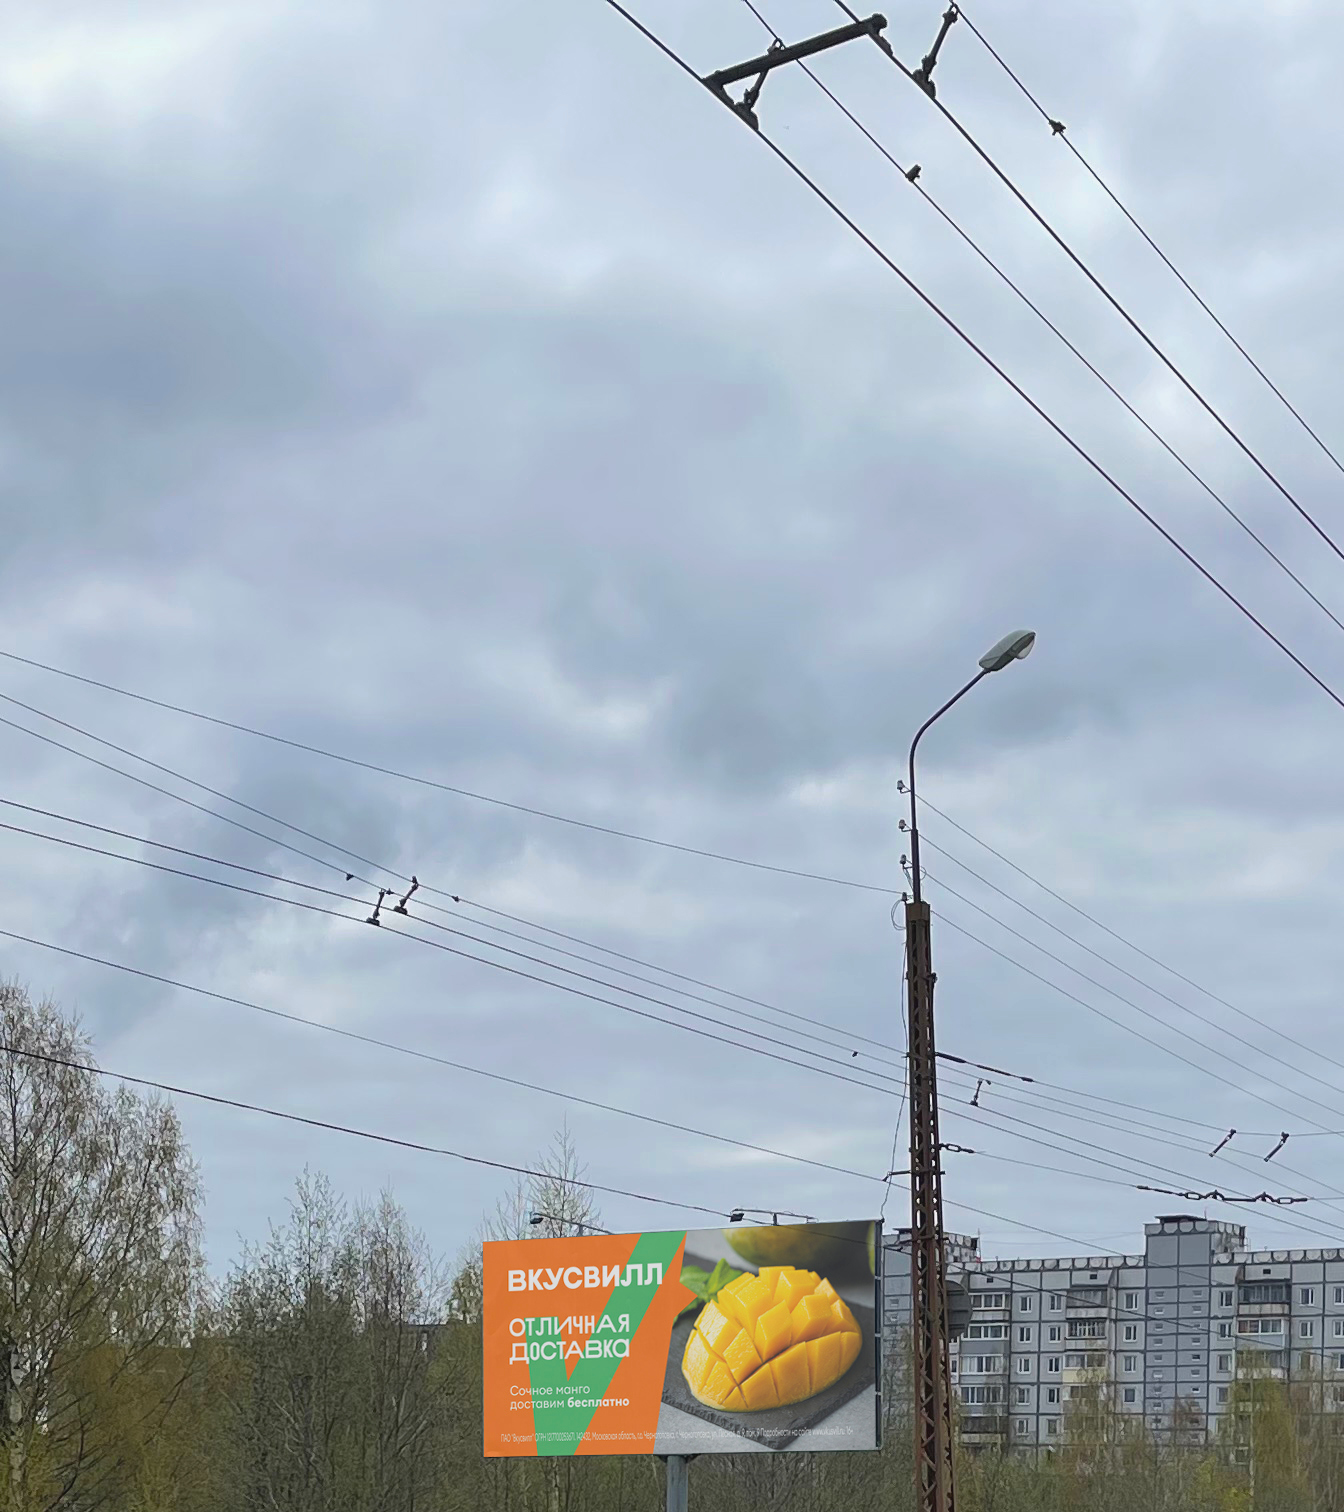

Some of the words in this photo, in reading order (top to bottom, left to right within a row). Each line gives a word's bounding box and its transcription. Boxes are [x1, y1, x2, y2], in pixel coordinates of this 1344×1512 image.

[508, 1262, 663, 1292] ВКУСВИЛЛ
[509, 1313, 630, 1337] ОТЛИЧНАЯ
[509, 1338, 630, 1365] ДОСТАВКА
[510, 1385, 553, 1396] Сочное
[556, 1385, 590, 1395] манго
[510, 1400, 565, 1411] доставим
[567, 1396, 630, 1408] бесплатно
